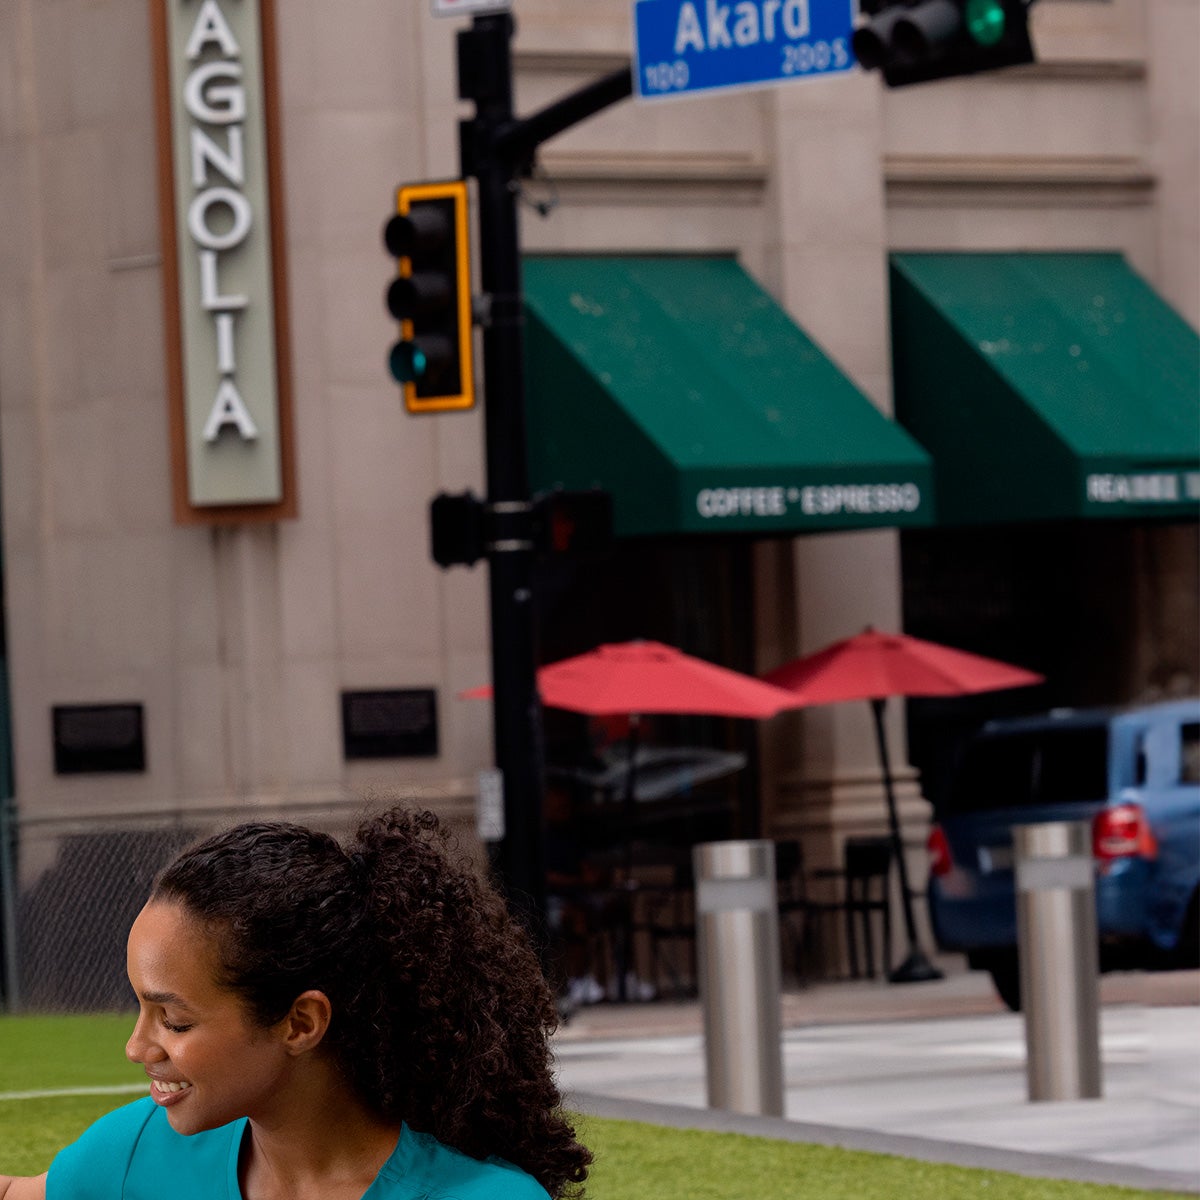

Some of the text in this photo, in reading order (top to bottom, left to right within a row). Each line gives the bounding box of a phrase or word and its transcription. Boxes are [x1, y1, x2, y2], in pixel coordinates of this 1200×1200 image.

[675, 0, 810, 54] Akard
[645, 60, 690, 91] 100
[183, 0, 257, 441] AGNOLIA
[696, 483, 920, 518] COFFEE ESPRESSO
